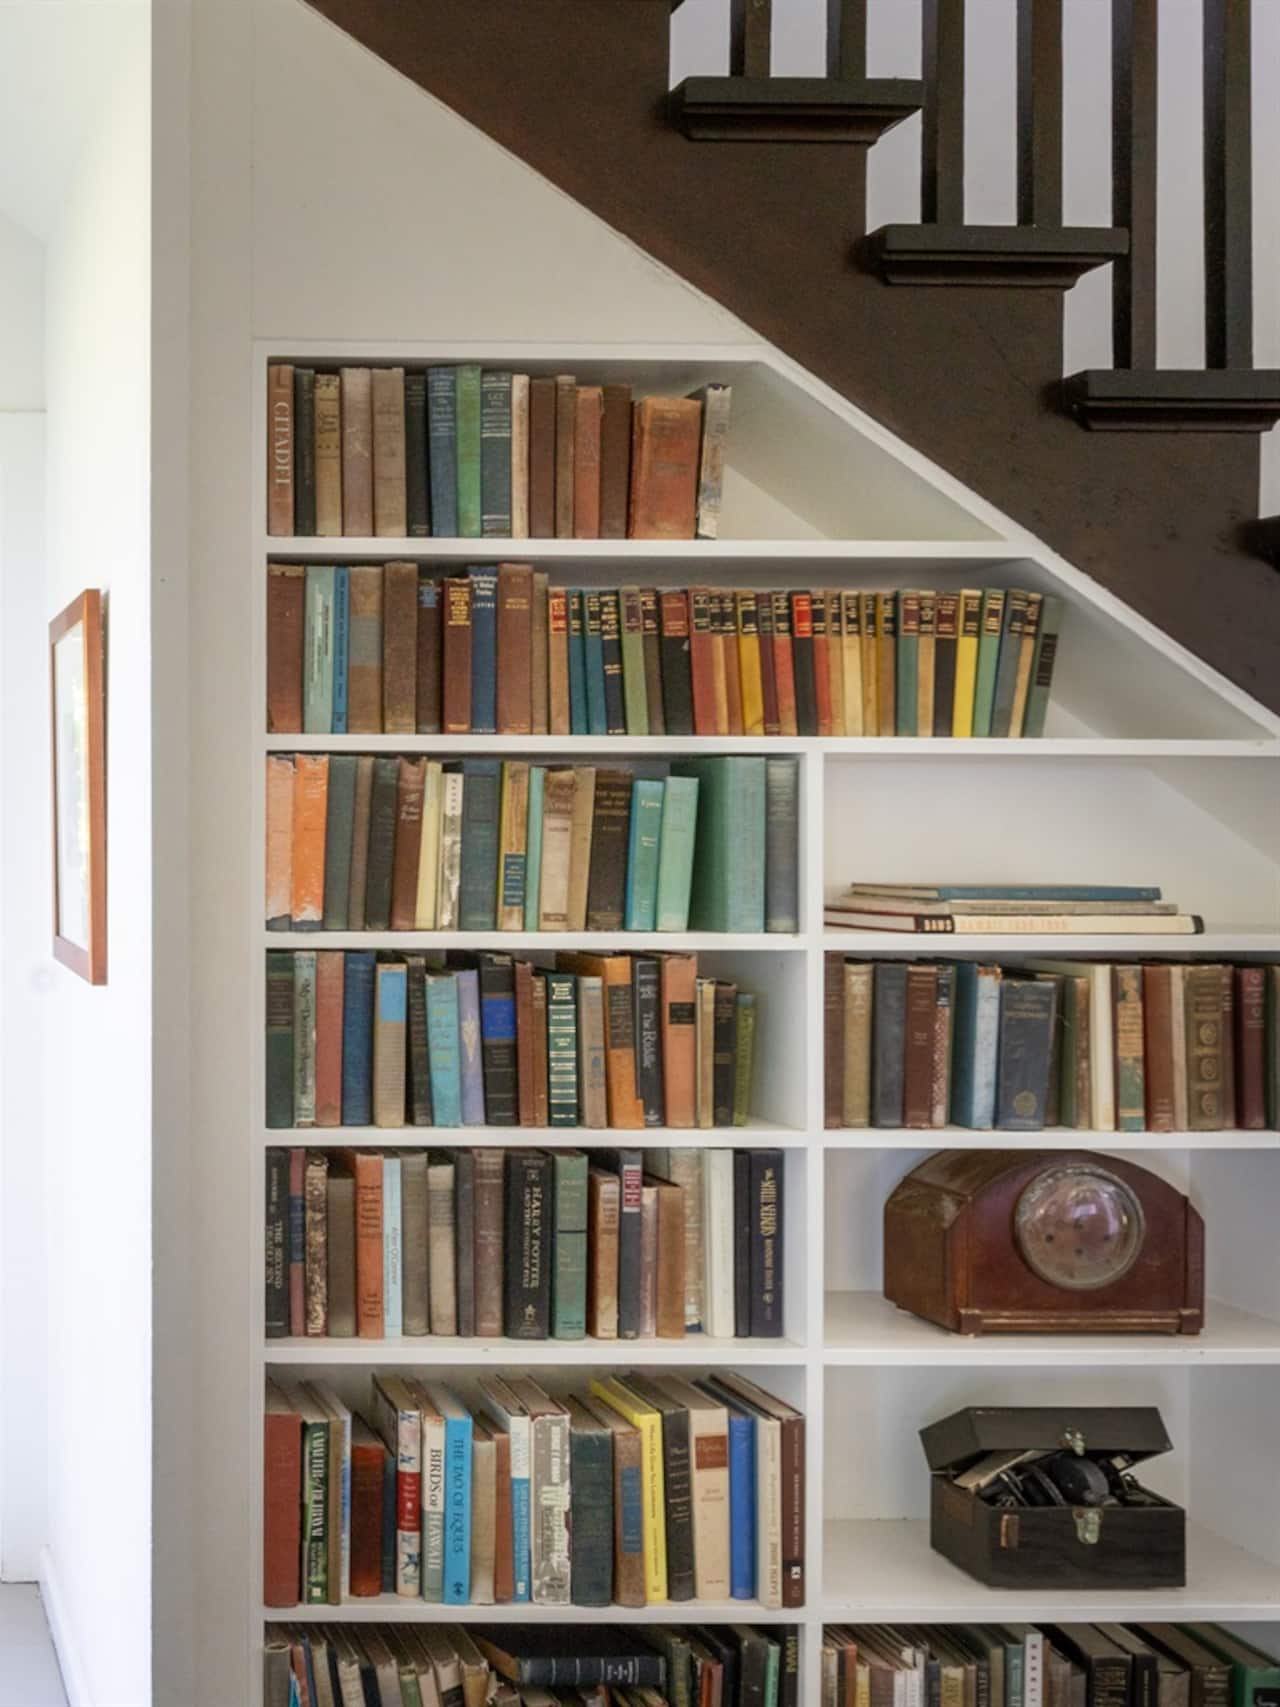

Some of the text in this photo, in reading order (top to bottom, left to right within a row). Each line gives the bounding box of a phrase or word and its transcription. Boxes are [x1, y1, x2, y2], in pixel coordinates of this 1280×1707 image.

[531, 1186, 543, 1239] HARRY
[430, 1448, 442, 1493] BIRDS
[454, 1466, 464, 1488] TAO
[427, 1513, 441, 1570] HAWAII
